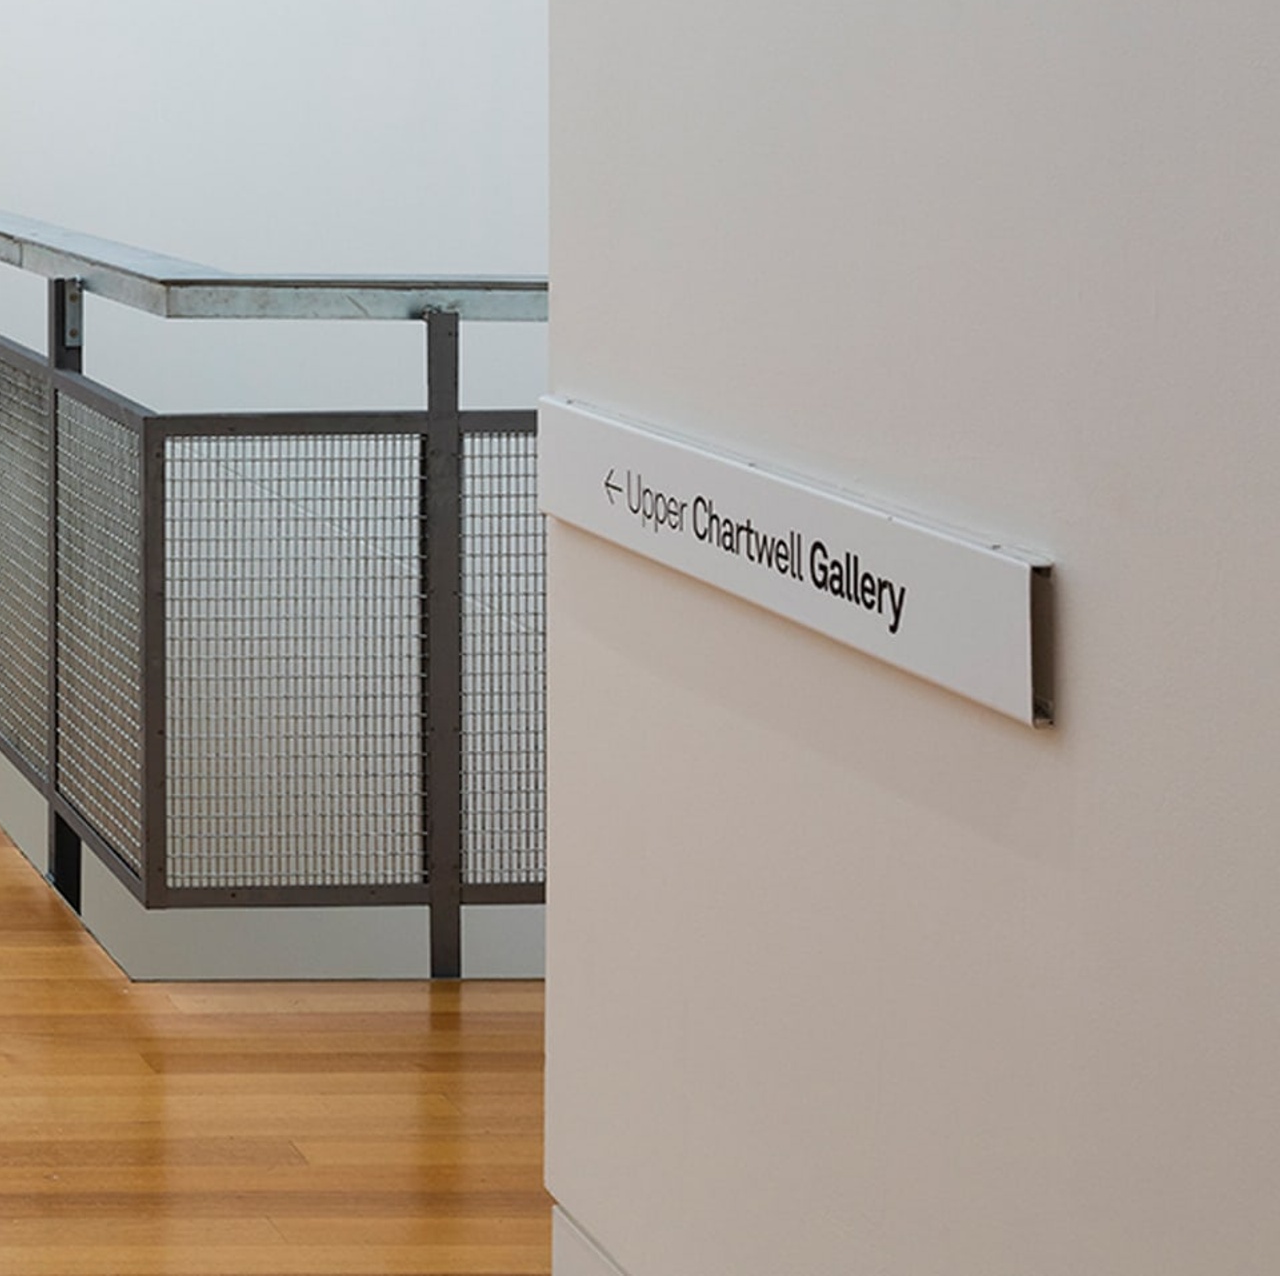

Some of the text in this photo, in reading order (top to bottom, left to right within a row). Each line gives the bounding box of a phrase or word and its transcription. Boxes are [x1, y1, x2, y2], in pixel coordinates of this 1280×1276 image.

[626, 470, 906, 633] Upper Chartwell Gallery
